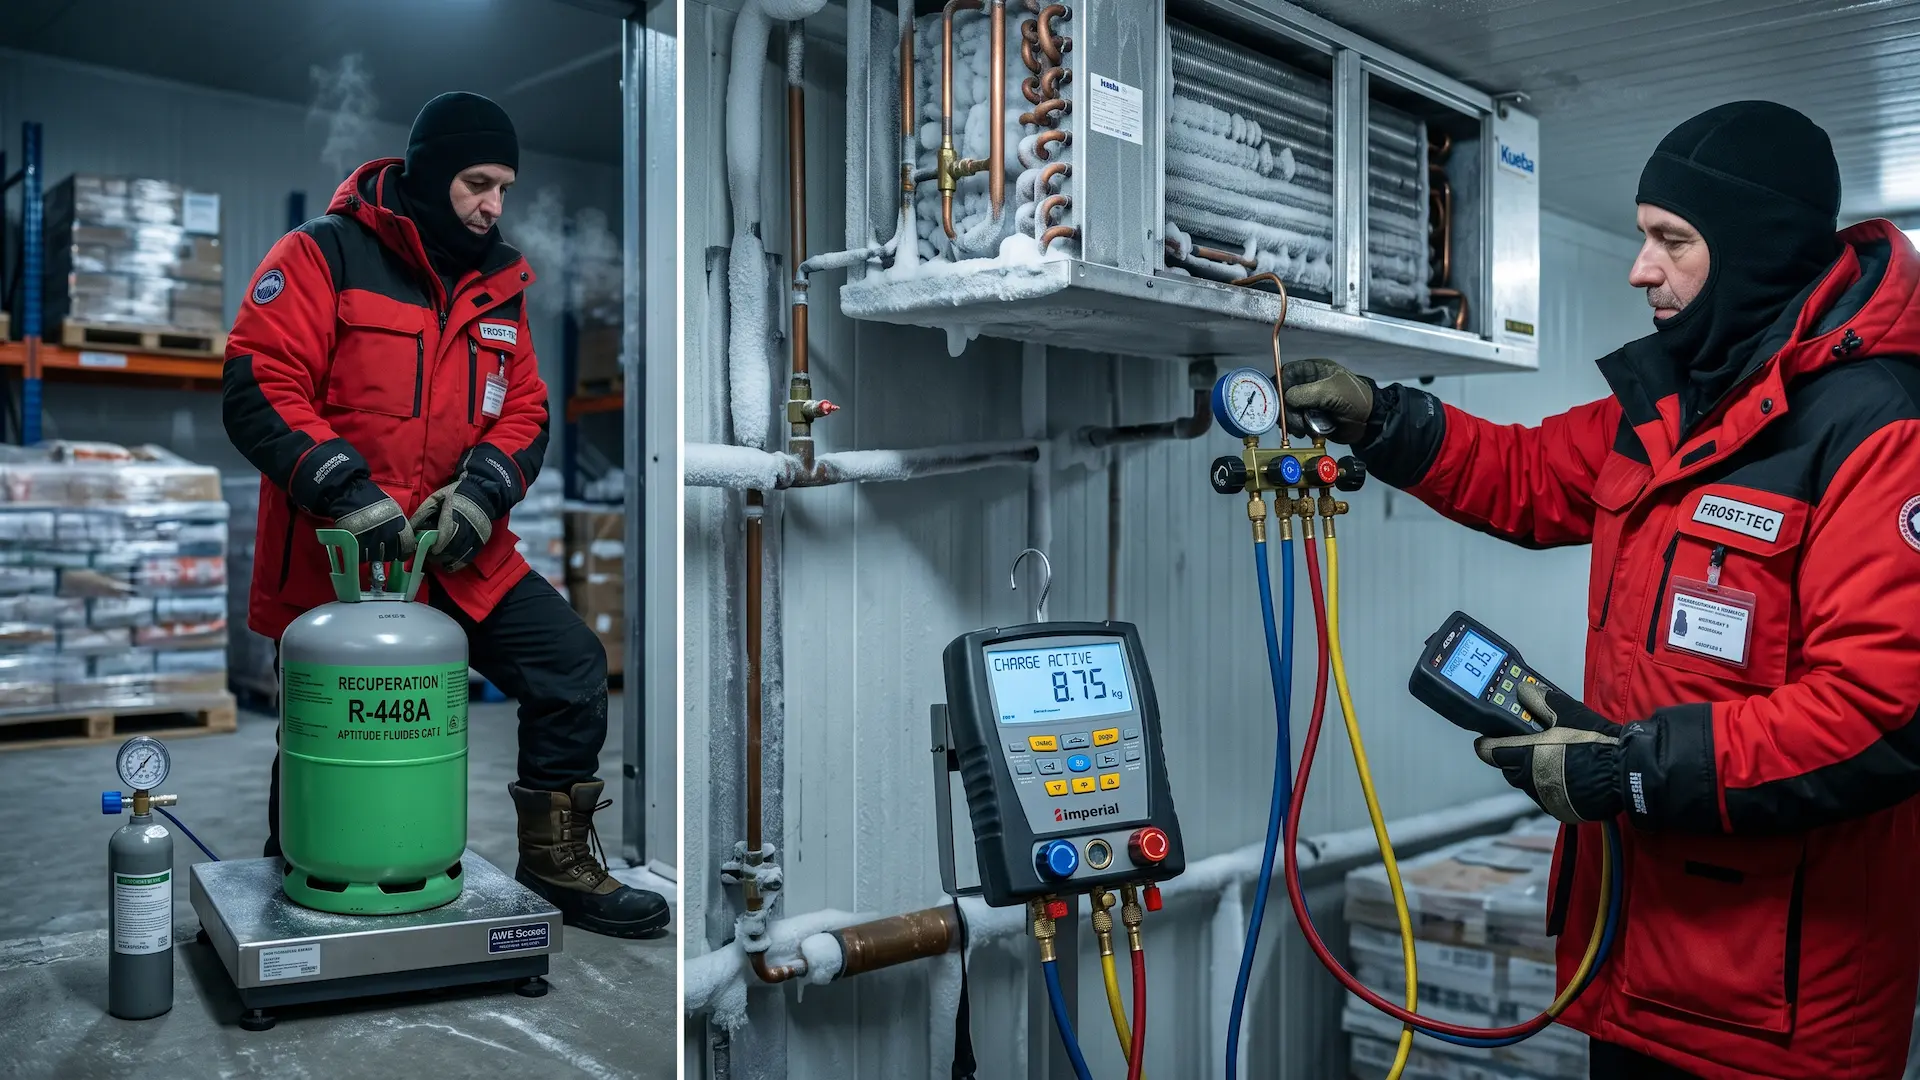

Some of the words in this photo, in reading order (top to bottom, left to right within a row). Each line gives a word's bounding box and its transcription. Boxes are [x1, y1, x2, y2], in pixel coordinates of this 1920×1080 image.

[1700, 502, 1775, 532] FROST-TEC
[994, 655, 1041, 672] CHARGE
[1048, 651, 1093, 668] ACTIVE
[338, 675, 439, 691] RECUPERATION
[1052, 668, 1107, 702] 8.75
[1111, 689, 1123, 699] kg
[349, 698, 431, 724] R-448A
[337, 729, 382, 741] APTITUDE
[383, 728, 420, 740] FLUIDES
[421, 727, 435, 738] CAT
[1063, 803, 1120, 821] imperial
[491, 930, 515, 941] AWE
